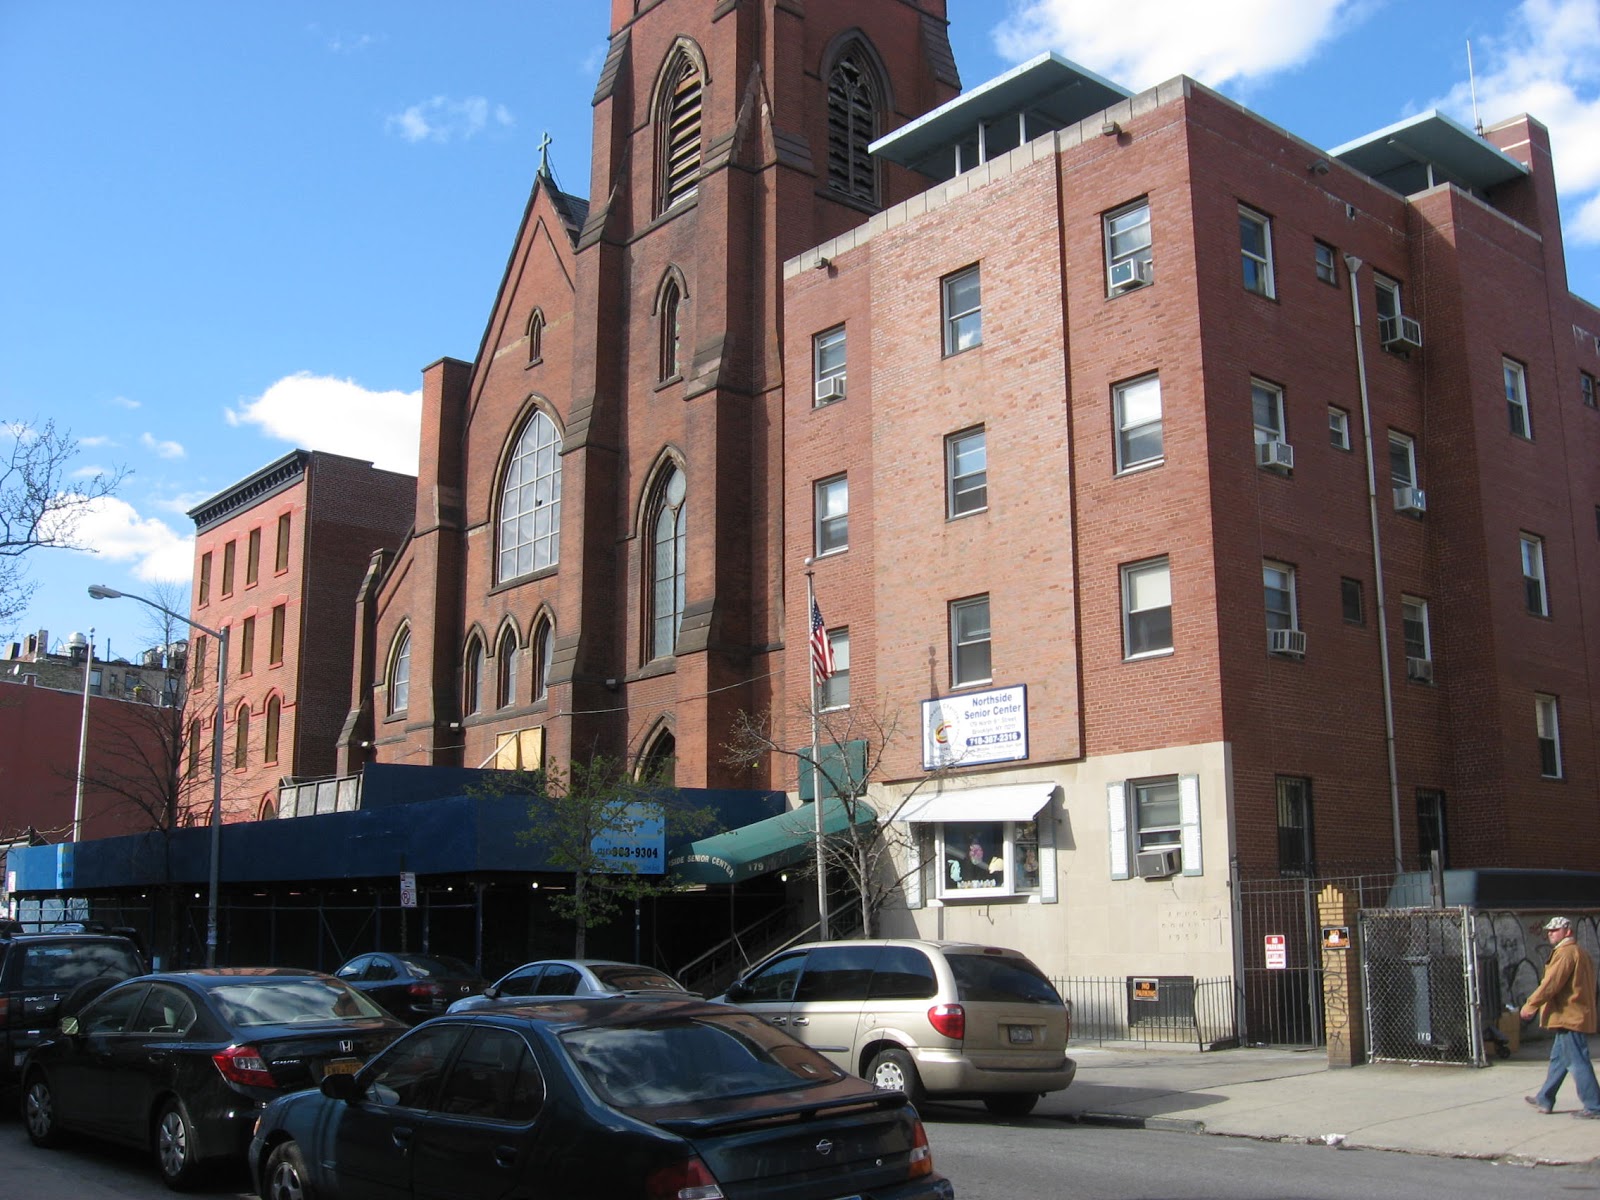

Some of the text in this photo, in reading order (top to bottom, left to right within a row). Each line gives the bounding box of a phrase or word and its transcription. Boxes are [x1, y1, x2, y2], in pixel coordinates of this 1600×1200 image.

[972, 693, 1012, 707] Northside
[964, 704, 1021, 719] Senior Center
[969, 732, 1018, 745] 718-387-2316
[687, 854, 709, 863] SENIOR
[711, 856, 735, 878] CENTER
[748, 862, 764, 872] 179
[1141, 982, 1151, 990] NO
